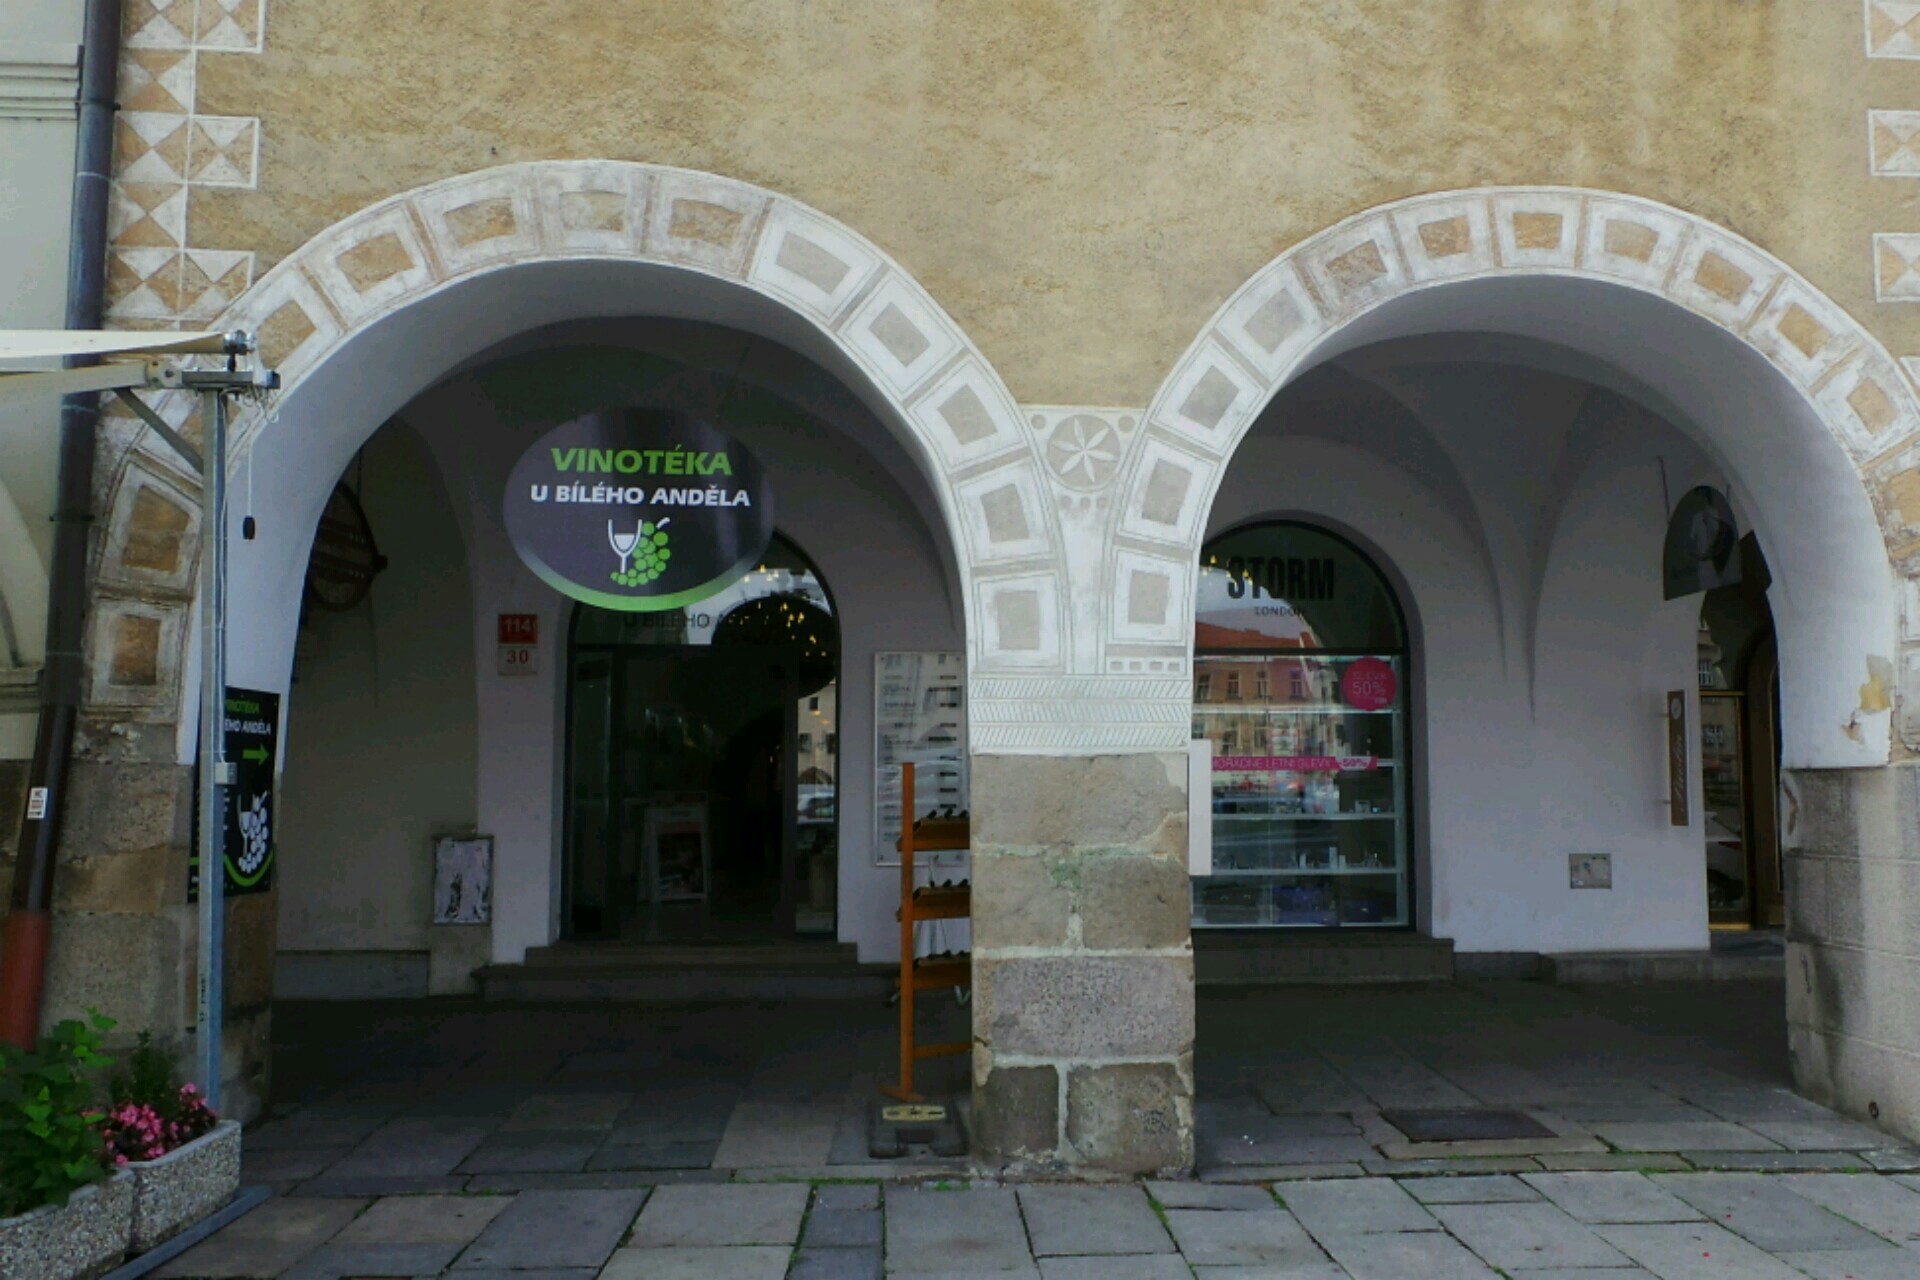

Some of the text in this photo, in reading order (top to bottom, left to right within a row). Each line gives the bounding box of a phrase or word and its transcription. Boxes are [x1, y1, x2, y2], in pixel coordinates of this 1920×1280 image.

[551, 444, 733, 476] VINOTÉKA
[530, 480, 752, 507] U BÍLÉHO ANDĚLA
[1227, 556, 1335, 600] STORM
[506, 649, 529, 665] 30
[1352, 681, 1388, 697] 50%
